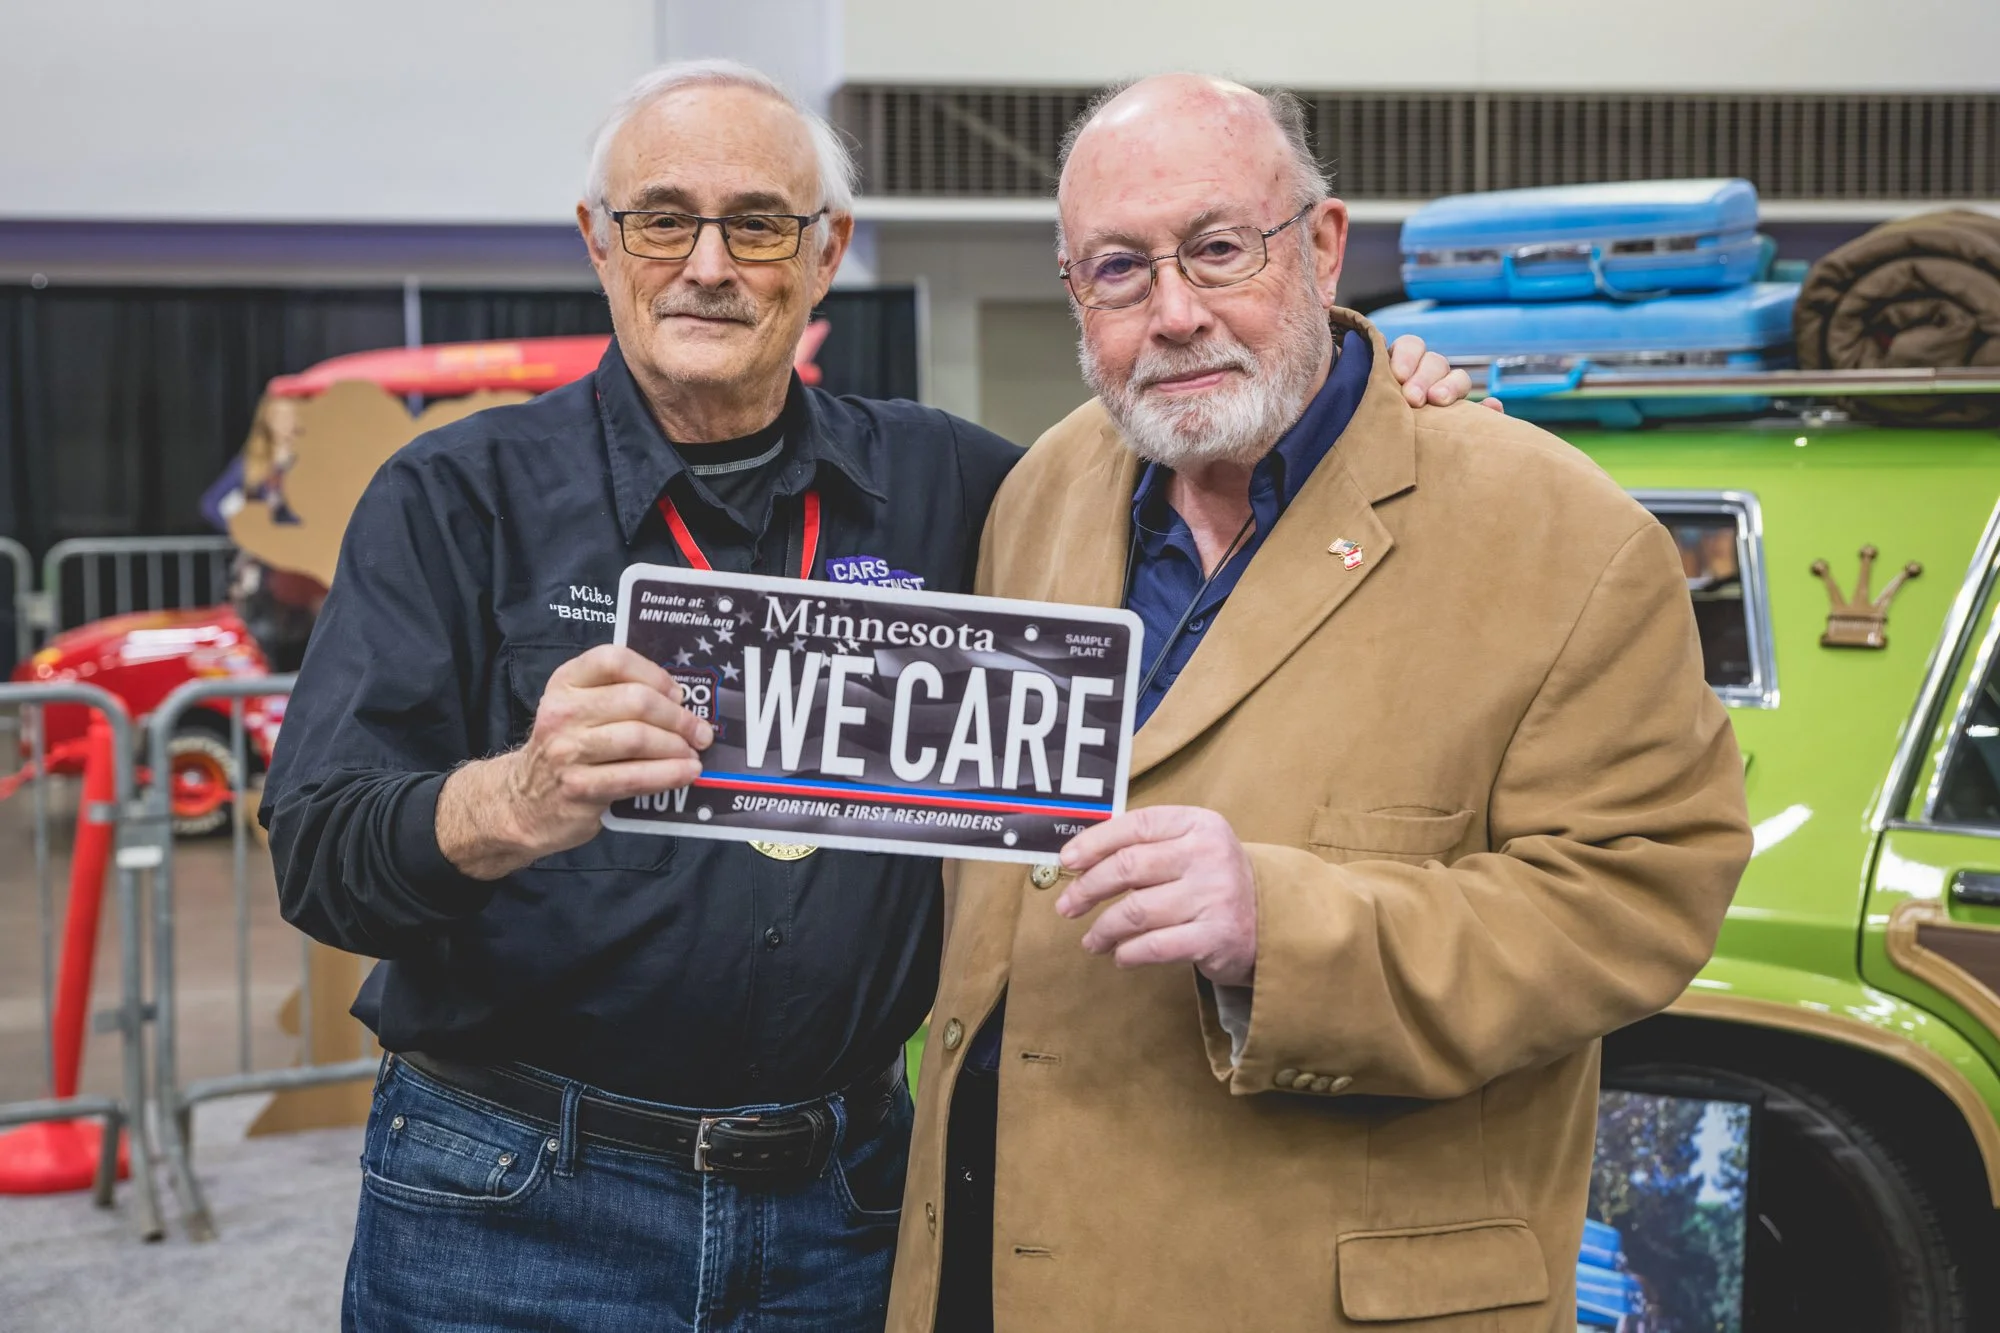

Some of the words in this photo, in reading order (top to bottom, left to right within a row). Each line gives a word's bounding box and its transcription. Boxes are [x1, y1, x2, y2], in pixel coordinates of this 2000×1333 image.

[833, 560, 889, 580] CARS
[569, 585, 614, 606] Mike
[641, 591, 685, 606] Donate
[688, 597, 705, 608] at:
[549, 603, 616, 624] "Batma
[639, 608, 735, 631] MN100Club.org
[762, 596, 997, 653] Minnesota
[1065, 633, 1112, 647] SAMPLE
[1070, 645, 1105, 658] PLATE
[744, 645, 875, 778] WE
[889, 660, 1115, 797] CARE
[732, 795, 840, 818] SUPPORTING
[843, 804, 893, 821] FIRST
[894, 810, 1004, 832] RESPONDERS
